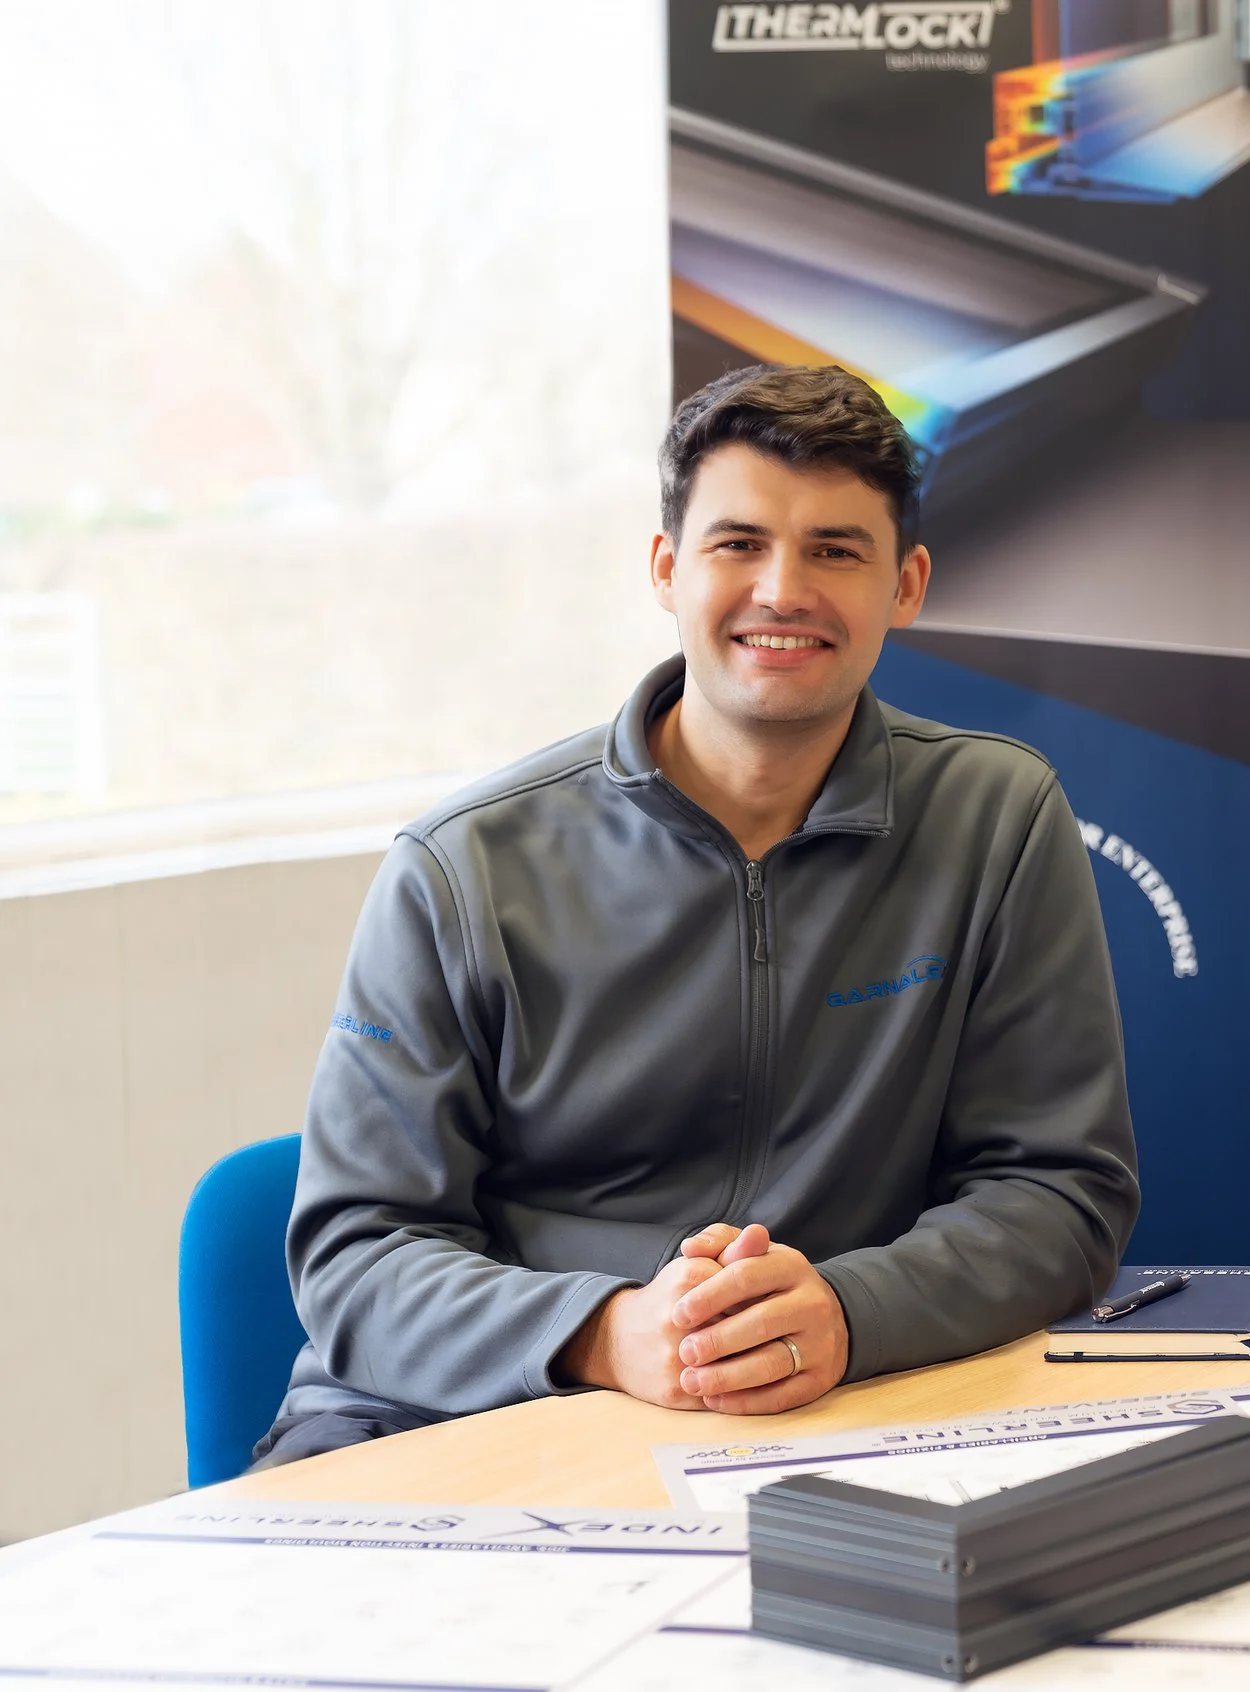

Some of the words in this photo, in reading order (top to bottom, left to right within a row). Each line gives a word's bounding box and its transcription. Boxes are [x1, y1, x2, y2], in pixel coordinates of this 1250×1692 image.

[718, 2, 988, 50] THERMLOCK
[1101, 833, 1199, 979] ENTERPRISE
[882, 1410, 1164, 1443] SHEERLINE
[175, 1514, 404, 1528] SHEERLINE
[479, 1511, 723, 1540] INDEX
